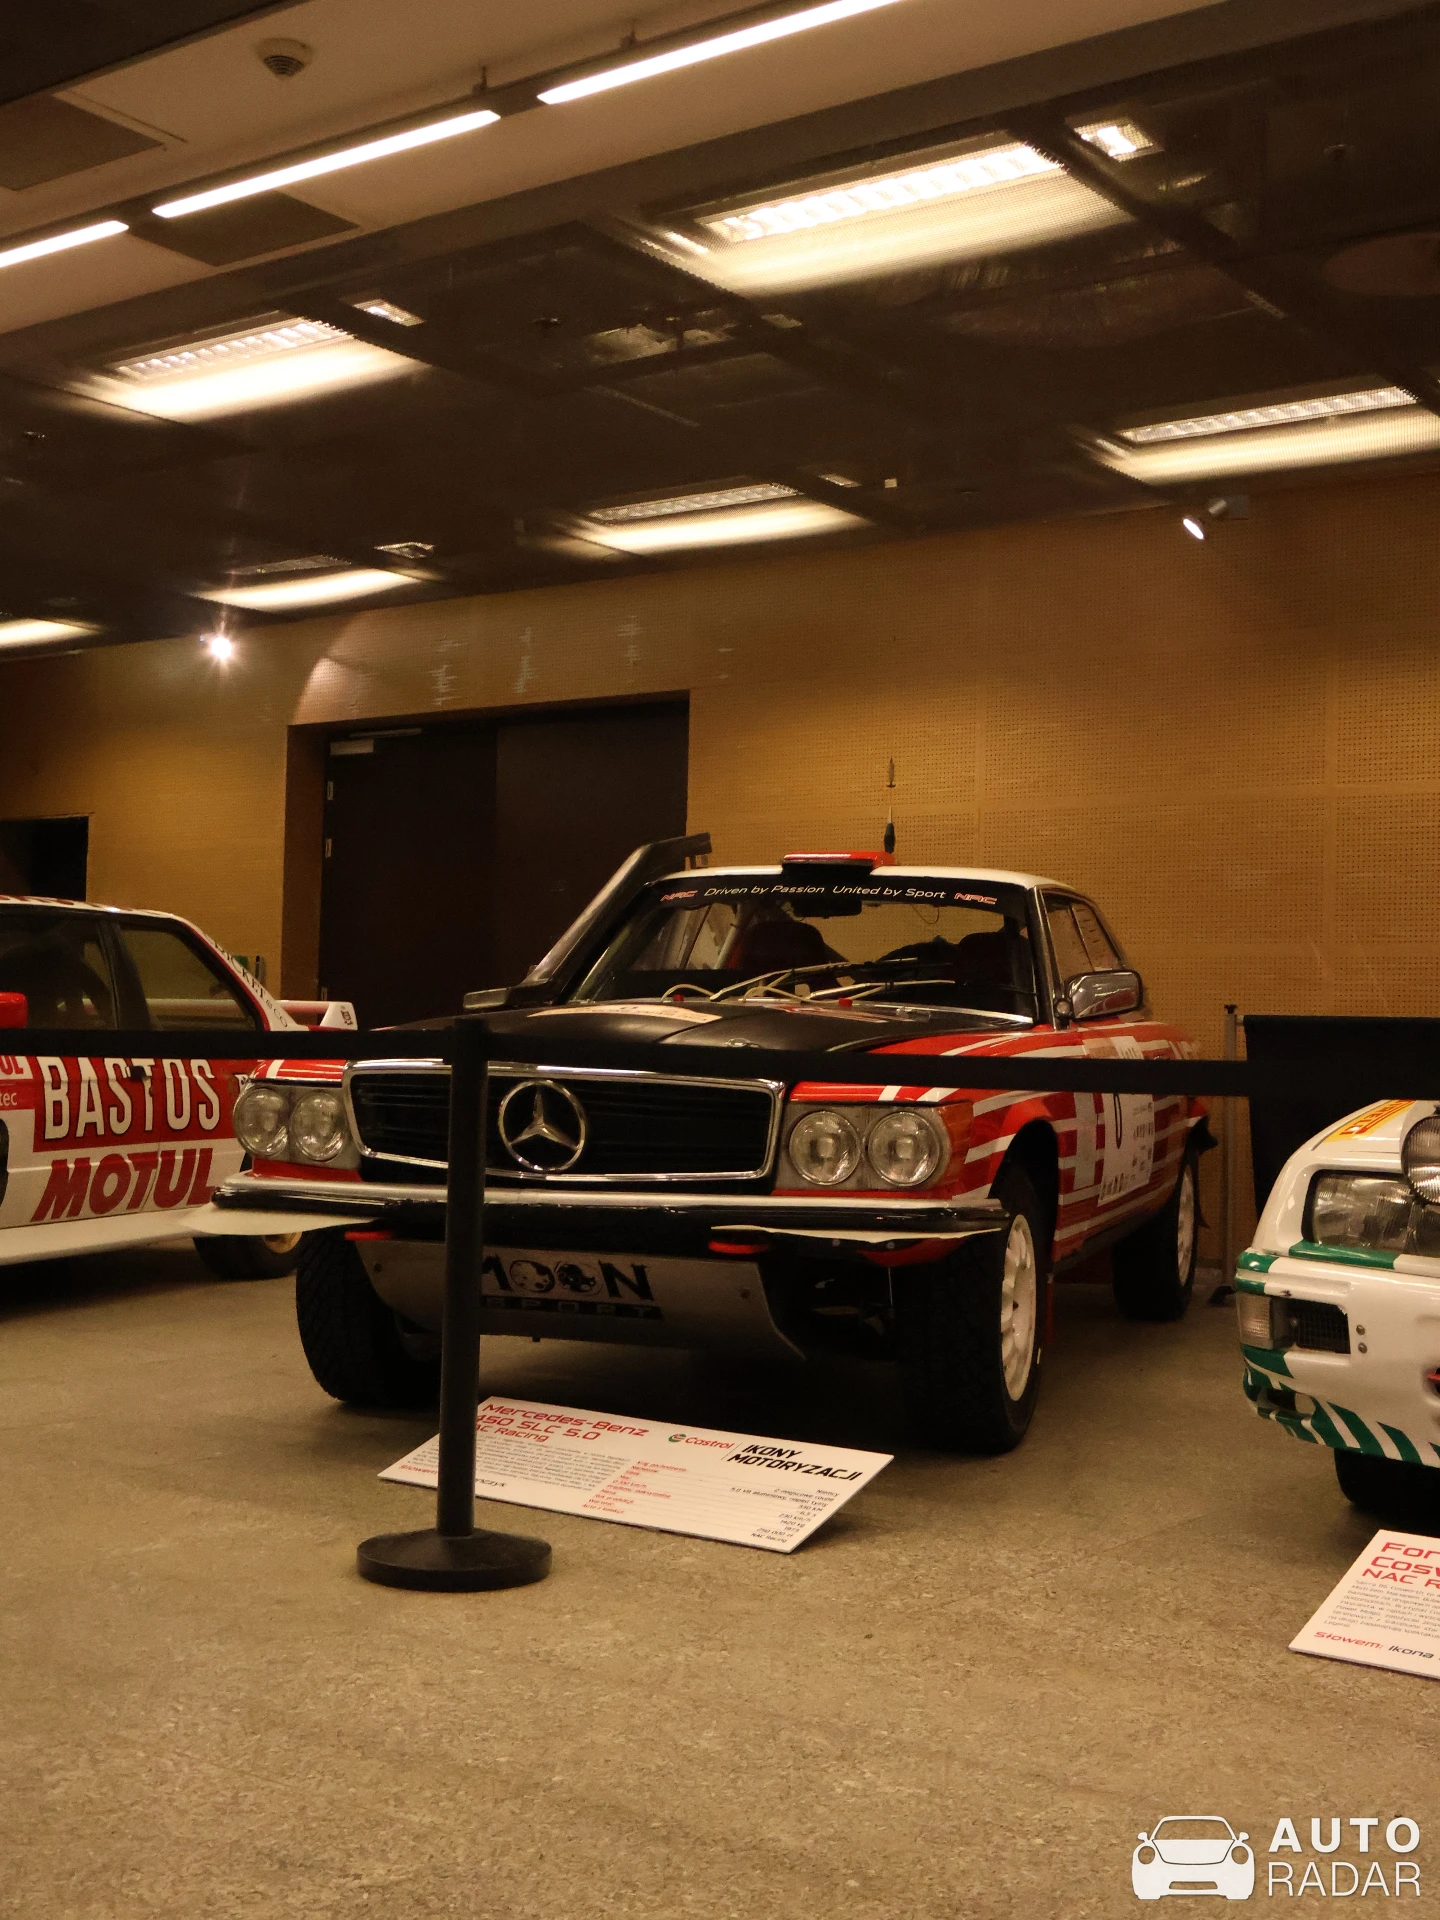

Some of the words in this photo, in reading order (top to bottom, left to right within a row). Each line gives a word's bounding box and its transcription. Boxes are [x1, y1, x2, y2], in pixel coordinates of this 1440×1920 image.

[704, 887, 748, 896] Driven
[751, 885, 769, 894] by
[771, 885, 825, 894] Passion
[832, 886, 881, 895] United
[883, 887, 902, 896] by
[905, 888, 946, 899] Sport
[37, 1057, 220, 1140] BASTOS
[30, 1148, 215, 1222] MOTUL
[482, 1404, 649, 1437] Mercedes-Benz
[494, 1427, 549, 1443] Racing
[517, 1421, 561, 1434] SLC
[563, 1428, 601, 1440] 5.0
[685, 1436, 734, 1449] Castrol
[742, 1444, 803, 1459] IKONY
[727, 1454, 863, 1481] MOTORYZACJI
[1371, 1556, 1440, 1577] Cos
[1362, 1568, 1417, 1585] NAC
[1313, 1631, 1384, 1649] Słowem:
[1388, 1645, 1434, 1659] Ikona
